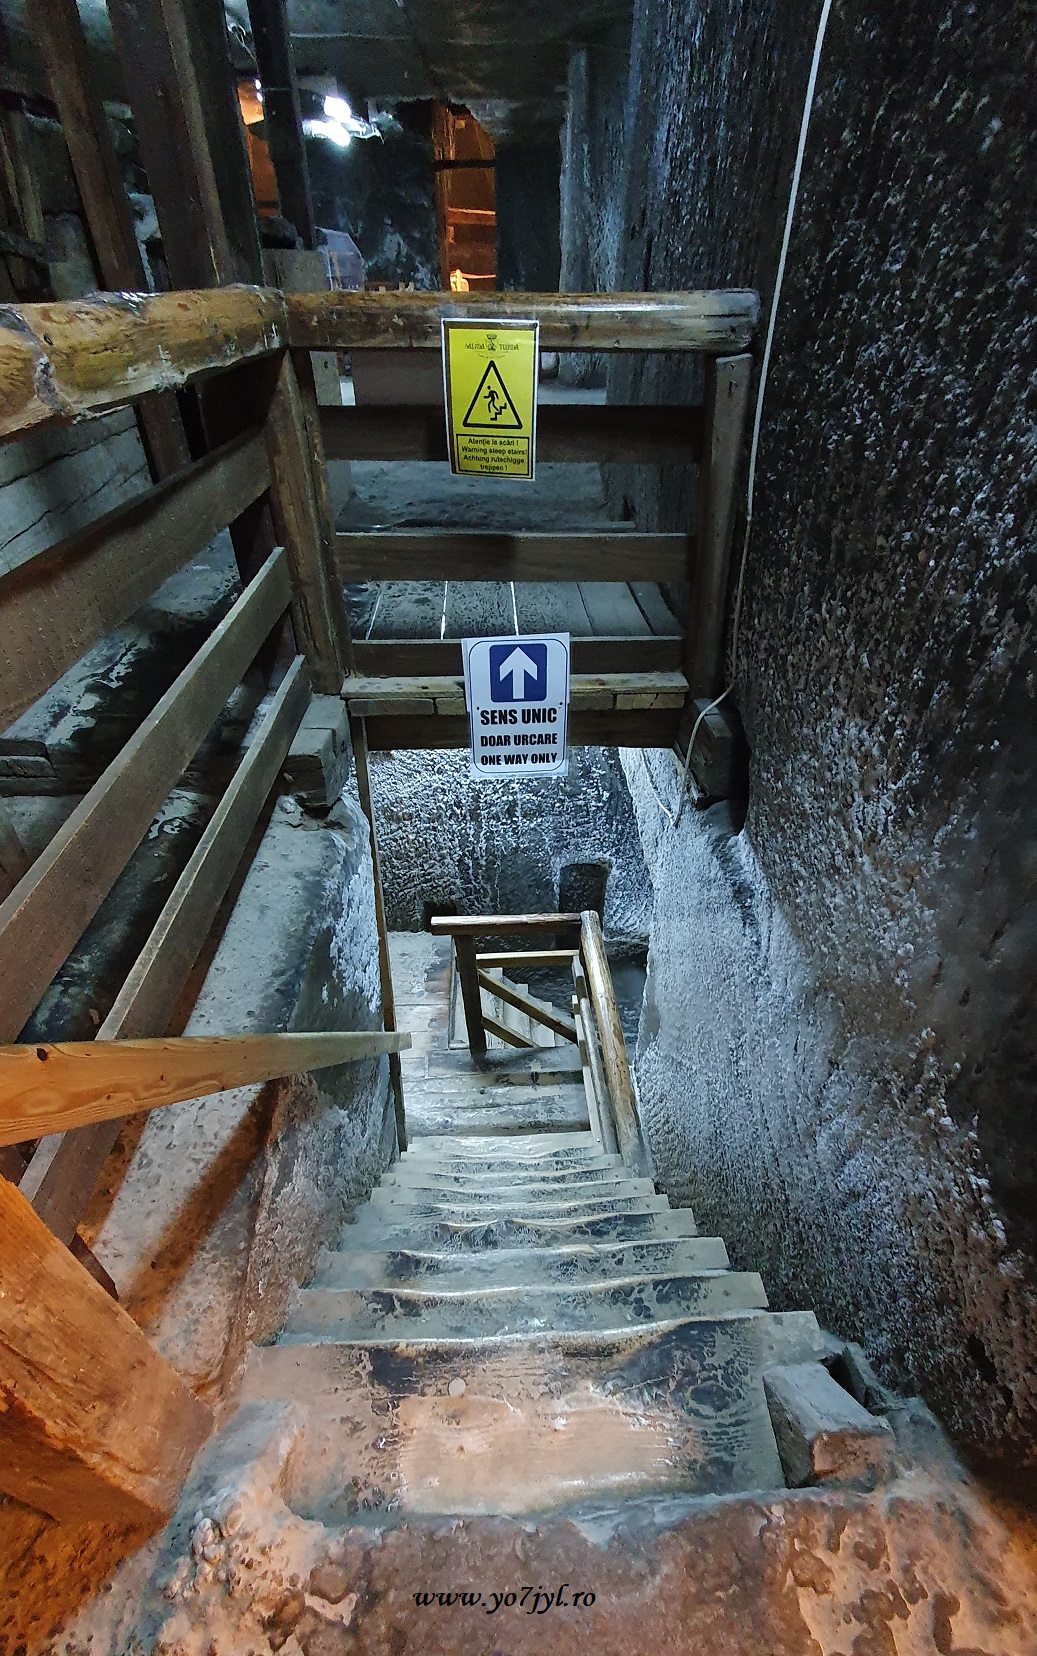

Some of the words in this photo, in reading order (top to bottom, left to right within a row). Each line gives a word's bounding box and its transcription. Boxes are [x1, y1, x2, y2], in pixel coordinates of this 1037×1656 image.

[462, 446, 487, 454] Warning
[489, 448, 506, 456] steep
[463, 455, 490, 463] Achtung
[480, 464, 504, 472] treppen
[480, 709, 518, 725] SENS
[521, 707, 557, 724] UNIC
[480, 735, 511, 747] DOAR
[513, 733, 558, 746] URCARE
[481, 755, 502, 765] ONE
[504, 754, 528, 765] WAY
[531, 753, 557, 764] ONLY
